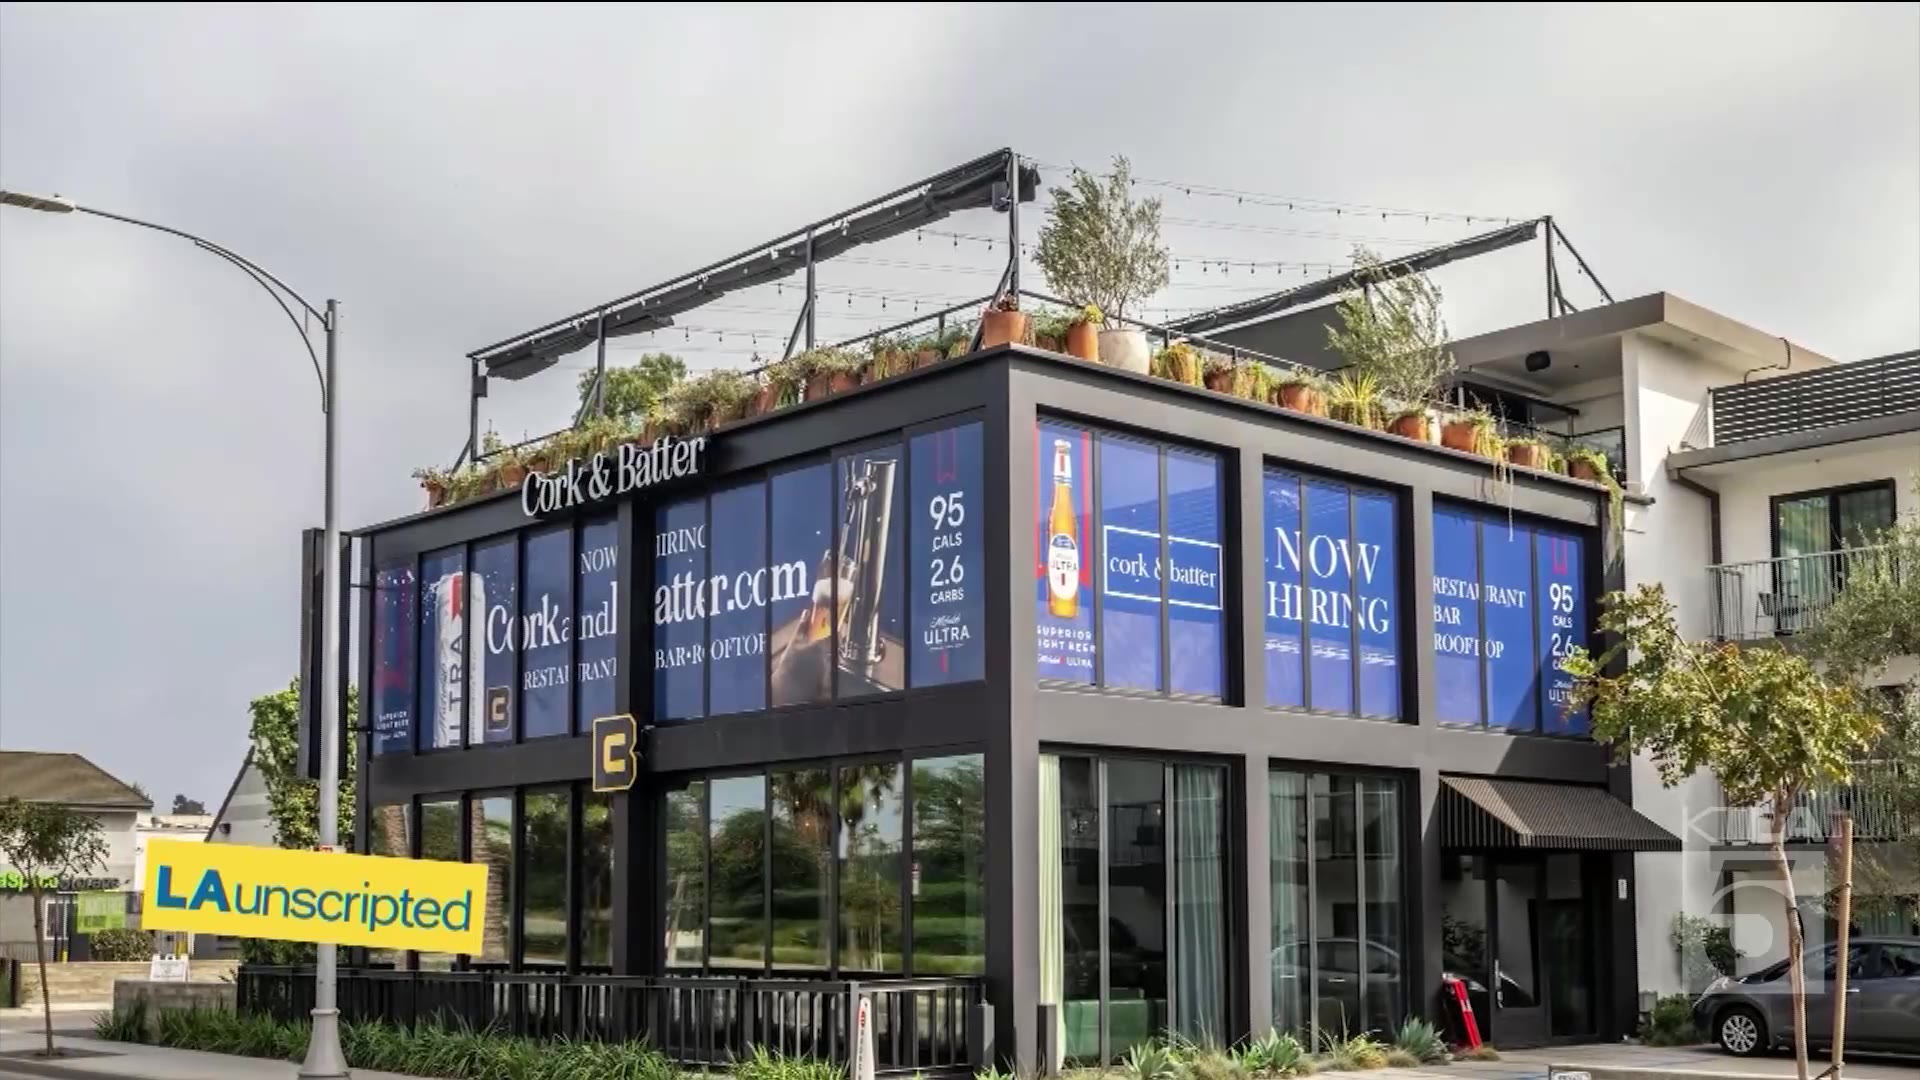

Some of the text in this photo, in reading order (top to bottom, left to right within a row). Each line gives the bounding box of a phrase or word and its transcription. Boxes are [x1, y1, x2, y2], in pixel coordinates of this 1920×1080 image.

[521, 436, 706, 517] Cork & Batter
[929, 491, 965, 530] 95
[932, 531, 963, 552] CALS
[1274, 527, 1381, 585] NOW
[581, 545, 619, 574] NOW
[930, 555, 964, 587] 2.6
[1109, 553, 1150, 578] cork
[1170, 558, 1217, 588] batter
[930, 587, 965, 604] CARBS
[1266, 581, 1389, 634] HIRING
[1432, 575, 1527, 609] RESTAURANT
[1549, 582, 1574, 613] 95
[1433, 604, 1461, 626] BAR
[924, 625, 971, 645] ULTRA
[1551, 633, 1575, 658] 2.6
